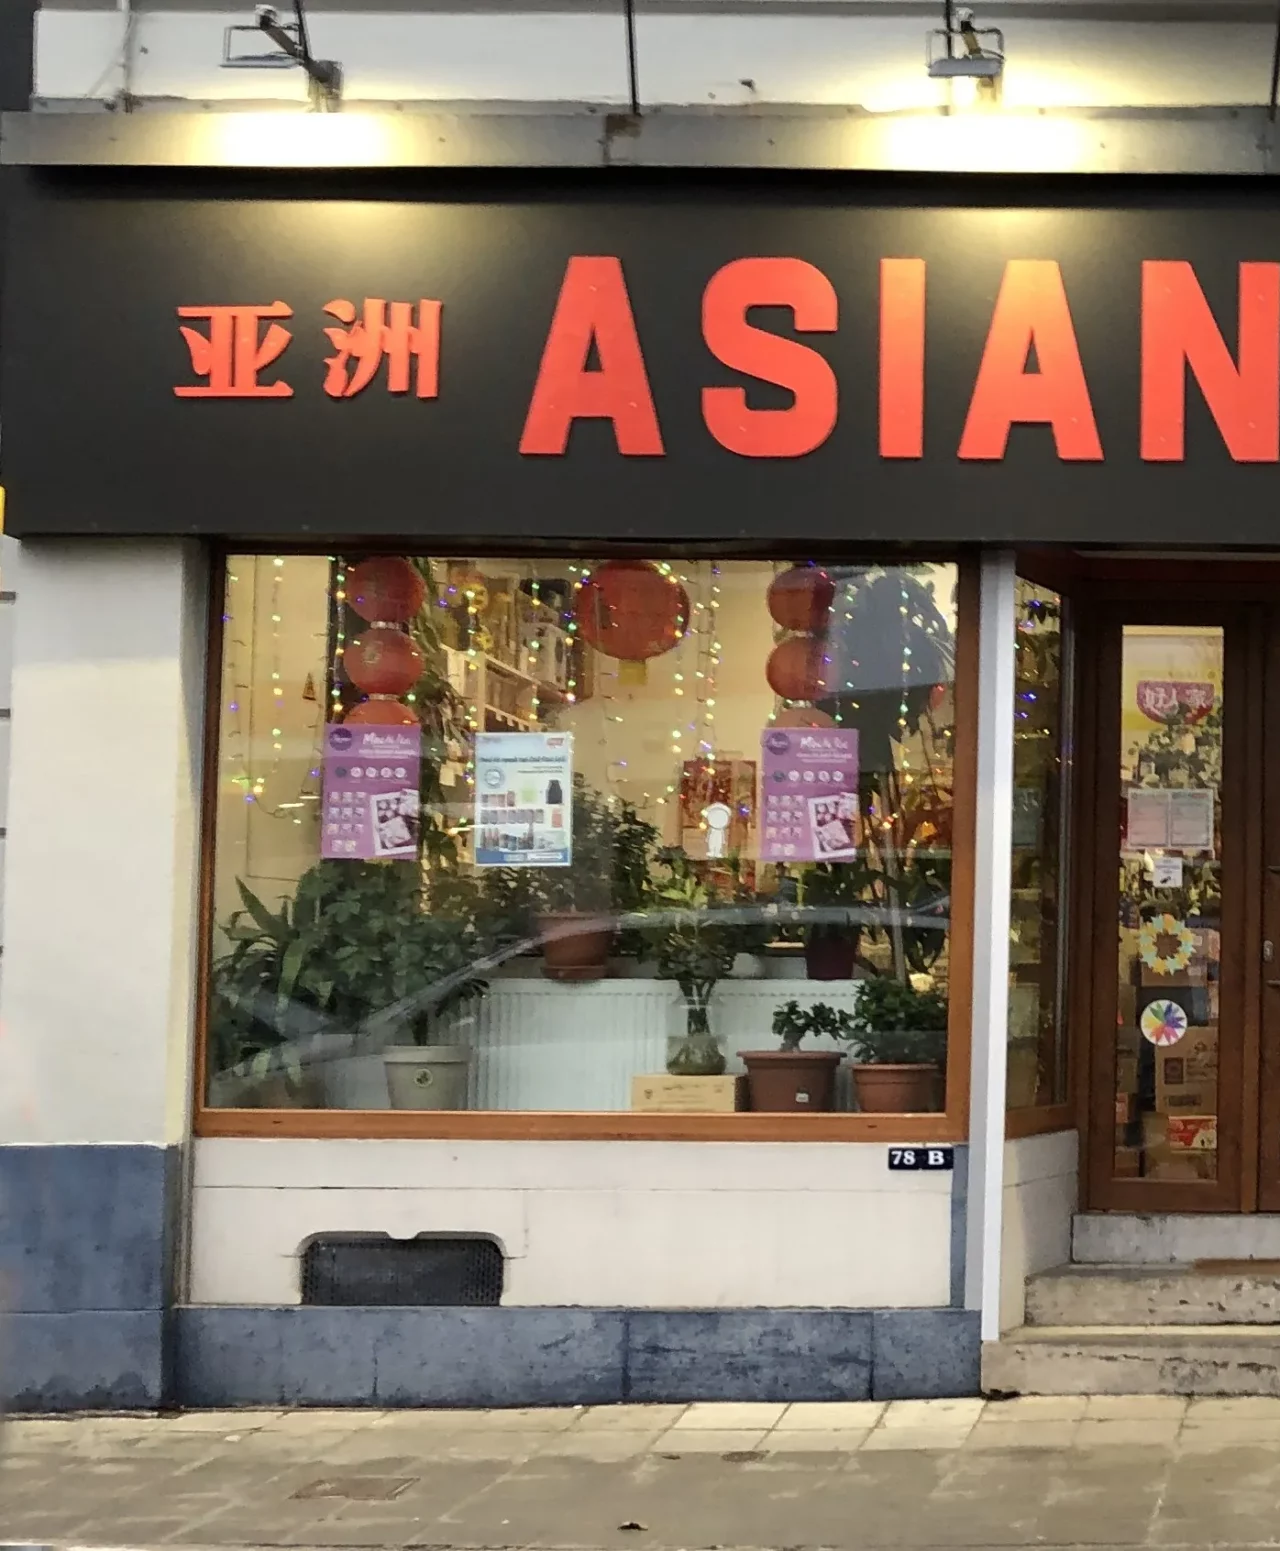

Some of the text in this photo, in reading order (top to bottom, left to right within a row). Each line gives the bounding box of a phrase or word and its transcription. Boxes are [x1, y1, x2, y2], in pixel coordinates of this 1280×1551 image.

[173, 298, 442, 399] 亚洲
[891, 1150, 944, 1165] 78 B
